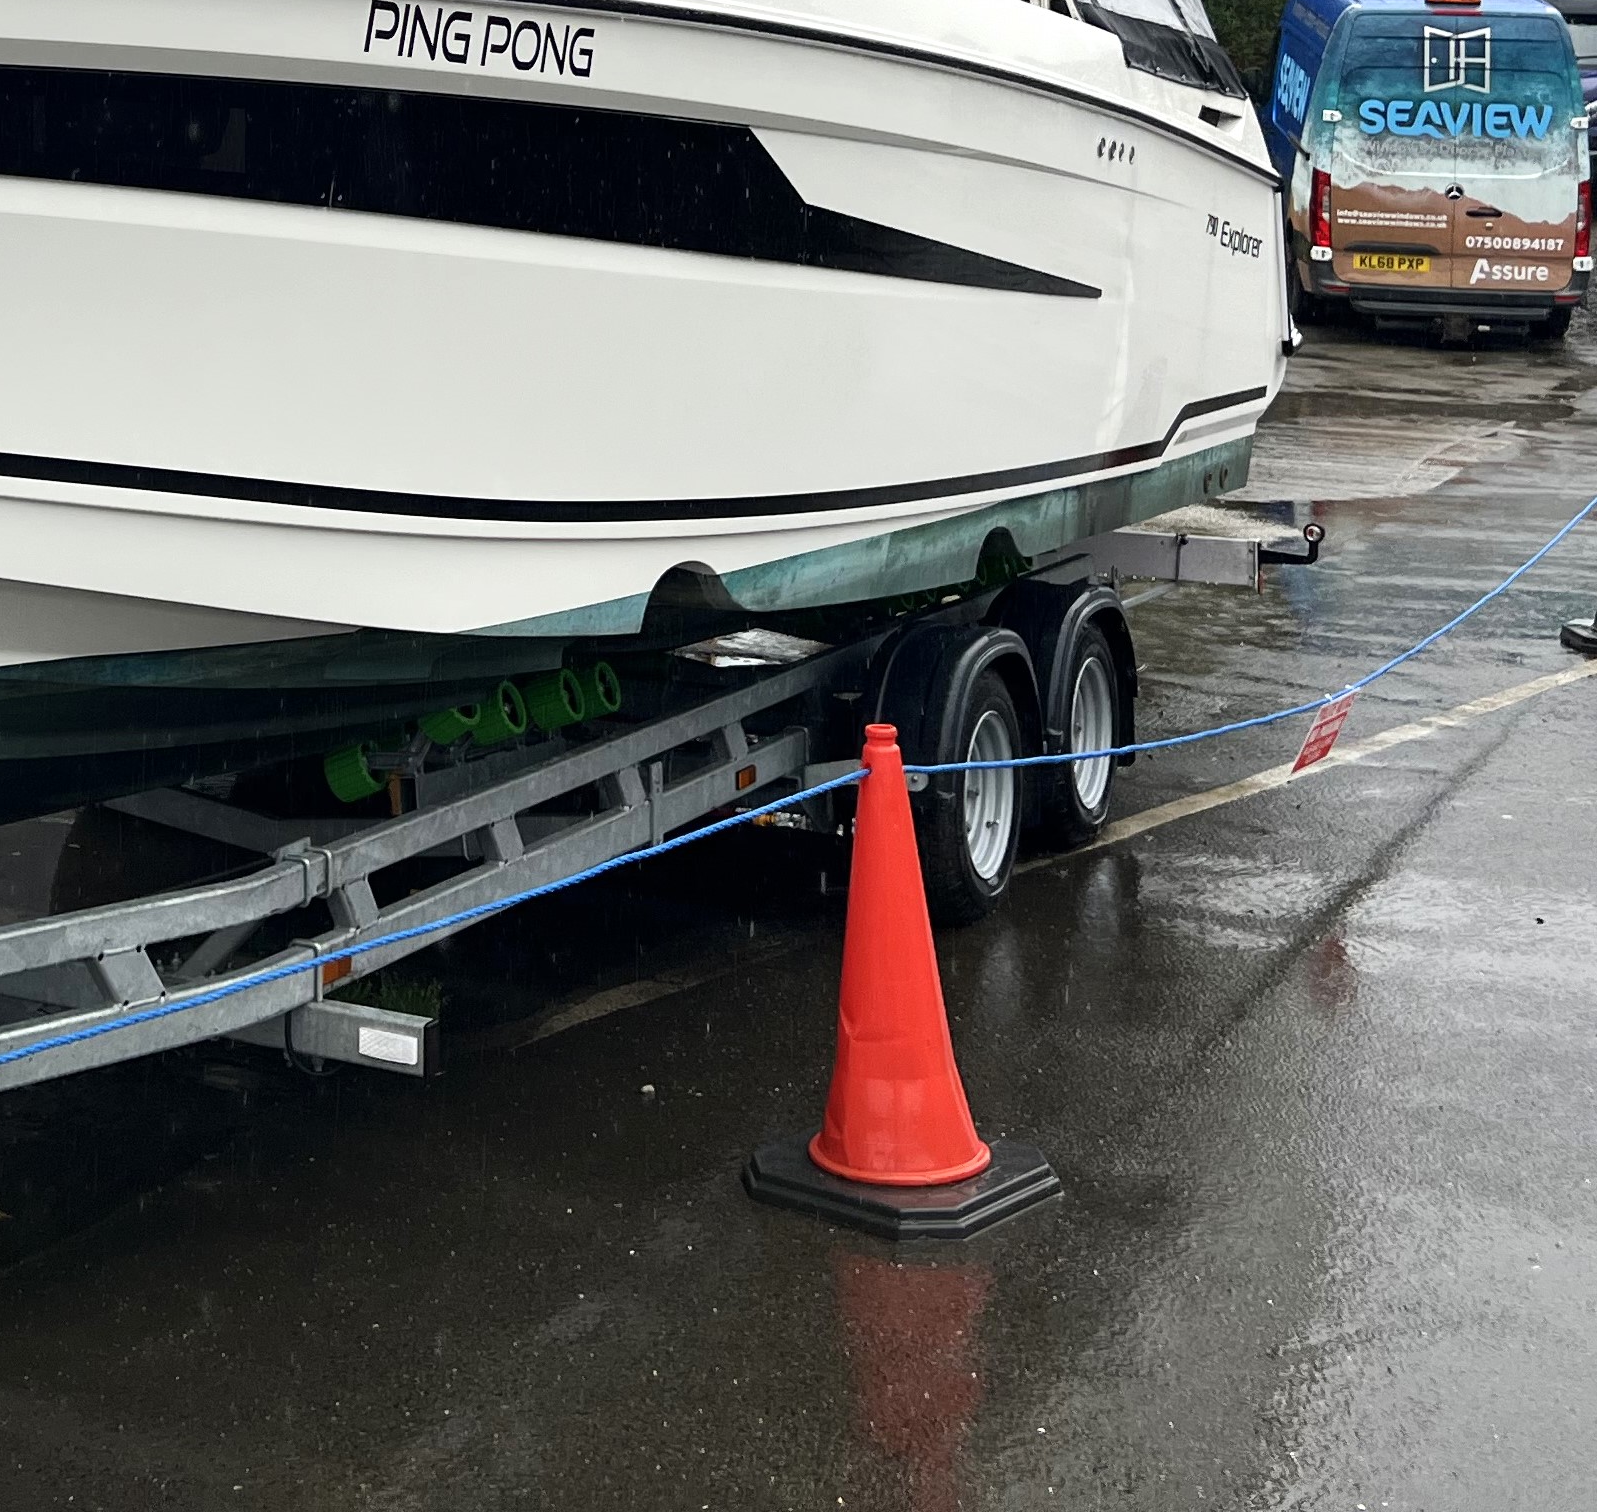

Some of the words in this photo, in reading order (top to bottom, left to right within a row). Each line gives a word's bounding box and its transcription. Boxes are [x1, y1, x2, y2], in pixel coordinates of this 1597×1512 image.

[364, 0, 473, 64] PING
[480, 15, 596, 78] PONG
[1358, 99, 1553, 139] SEAVIEW
[1220, 221, 1263, 258] Explorer
[1465, 236, 1564, 251] 07500894187
[1397, 257, 1424, 270] PXP
[1469, 258, 1549, 285] Assure
